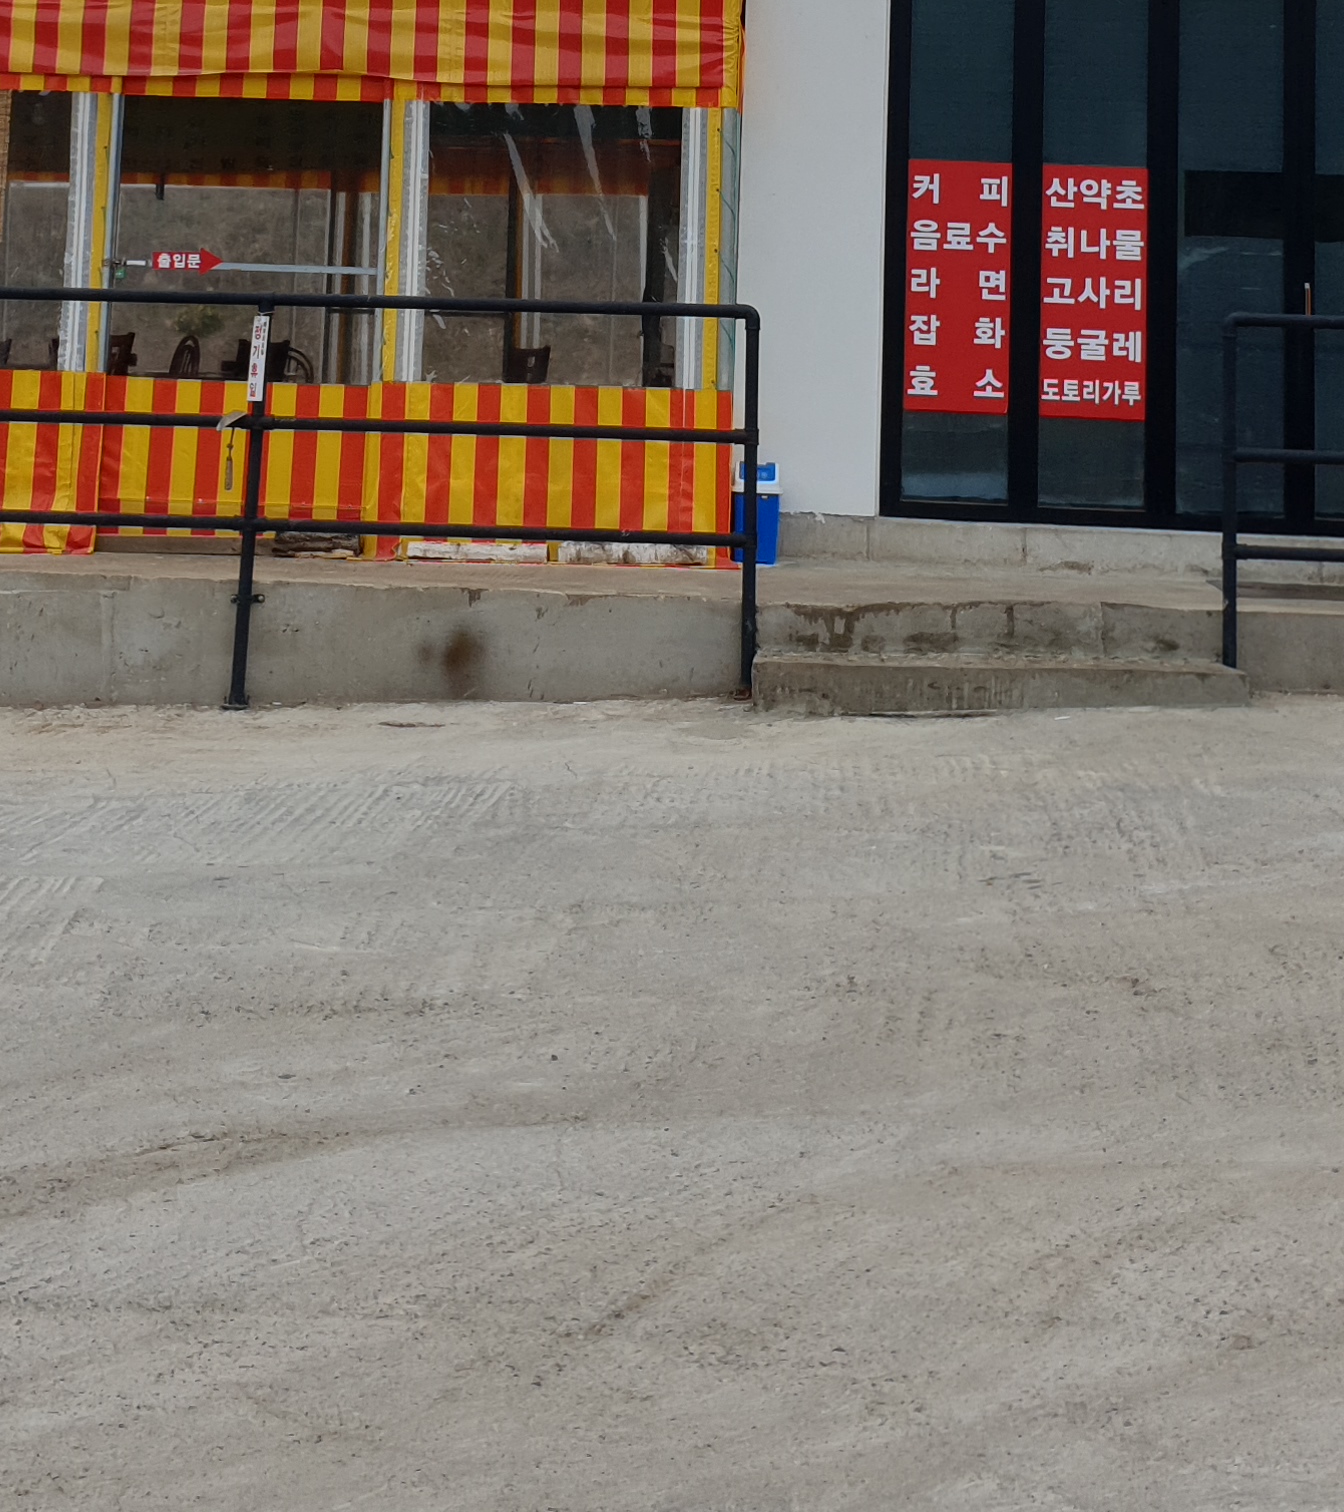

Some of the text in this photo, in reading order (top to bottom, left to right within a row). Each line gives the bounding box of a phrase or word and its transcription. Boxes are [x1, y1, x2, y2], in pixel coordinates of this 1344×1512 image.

[1045, 177, 1145, 210] 산약초
[910, 219, 1007, 254] 음료수
[1045, 226, 1145, 261] 취나물
[157, 252, 201, 269] 출입문
[1043, 276, 1142, 311] 고사리
[1042, 327, 1142, 363] 둥굴레
[1041, 378, 1142, 406] 도토리가루
